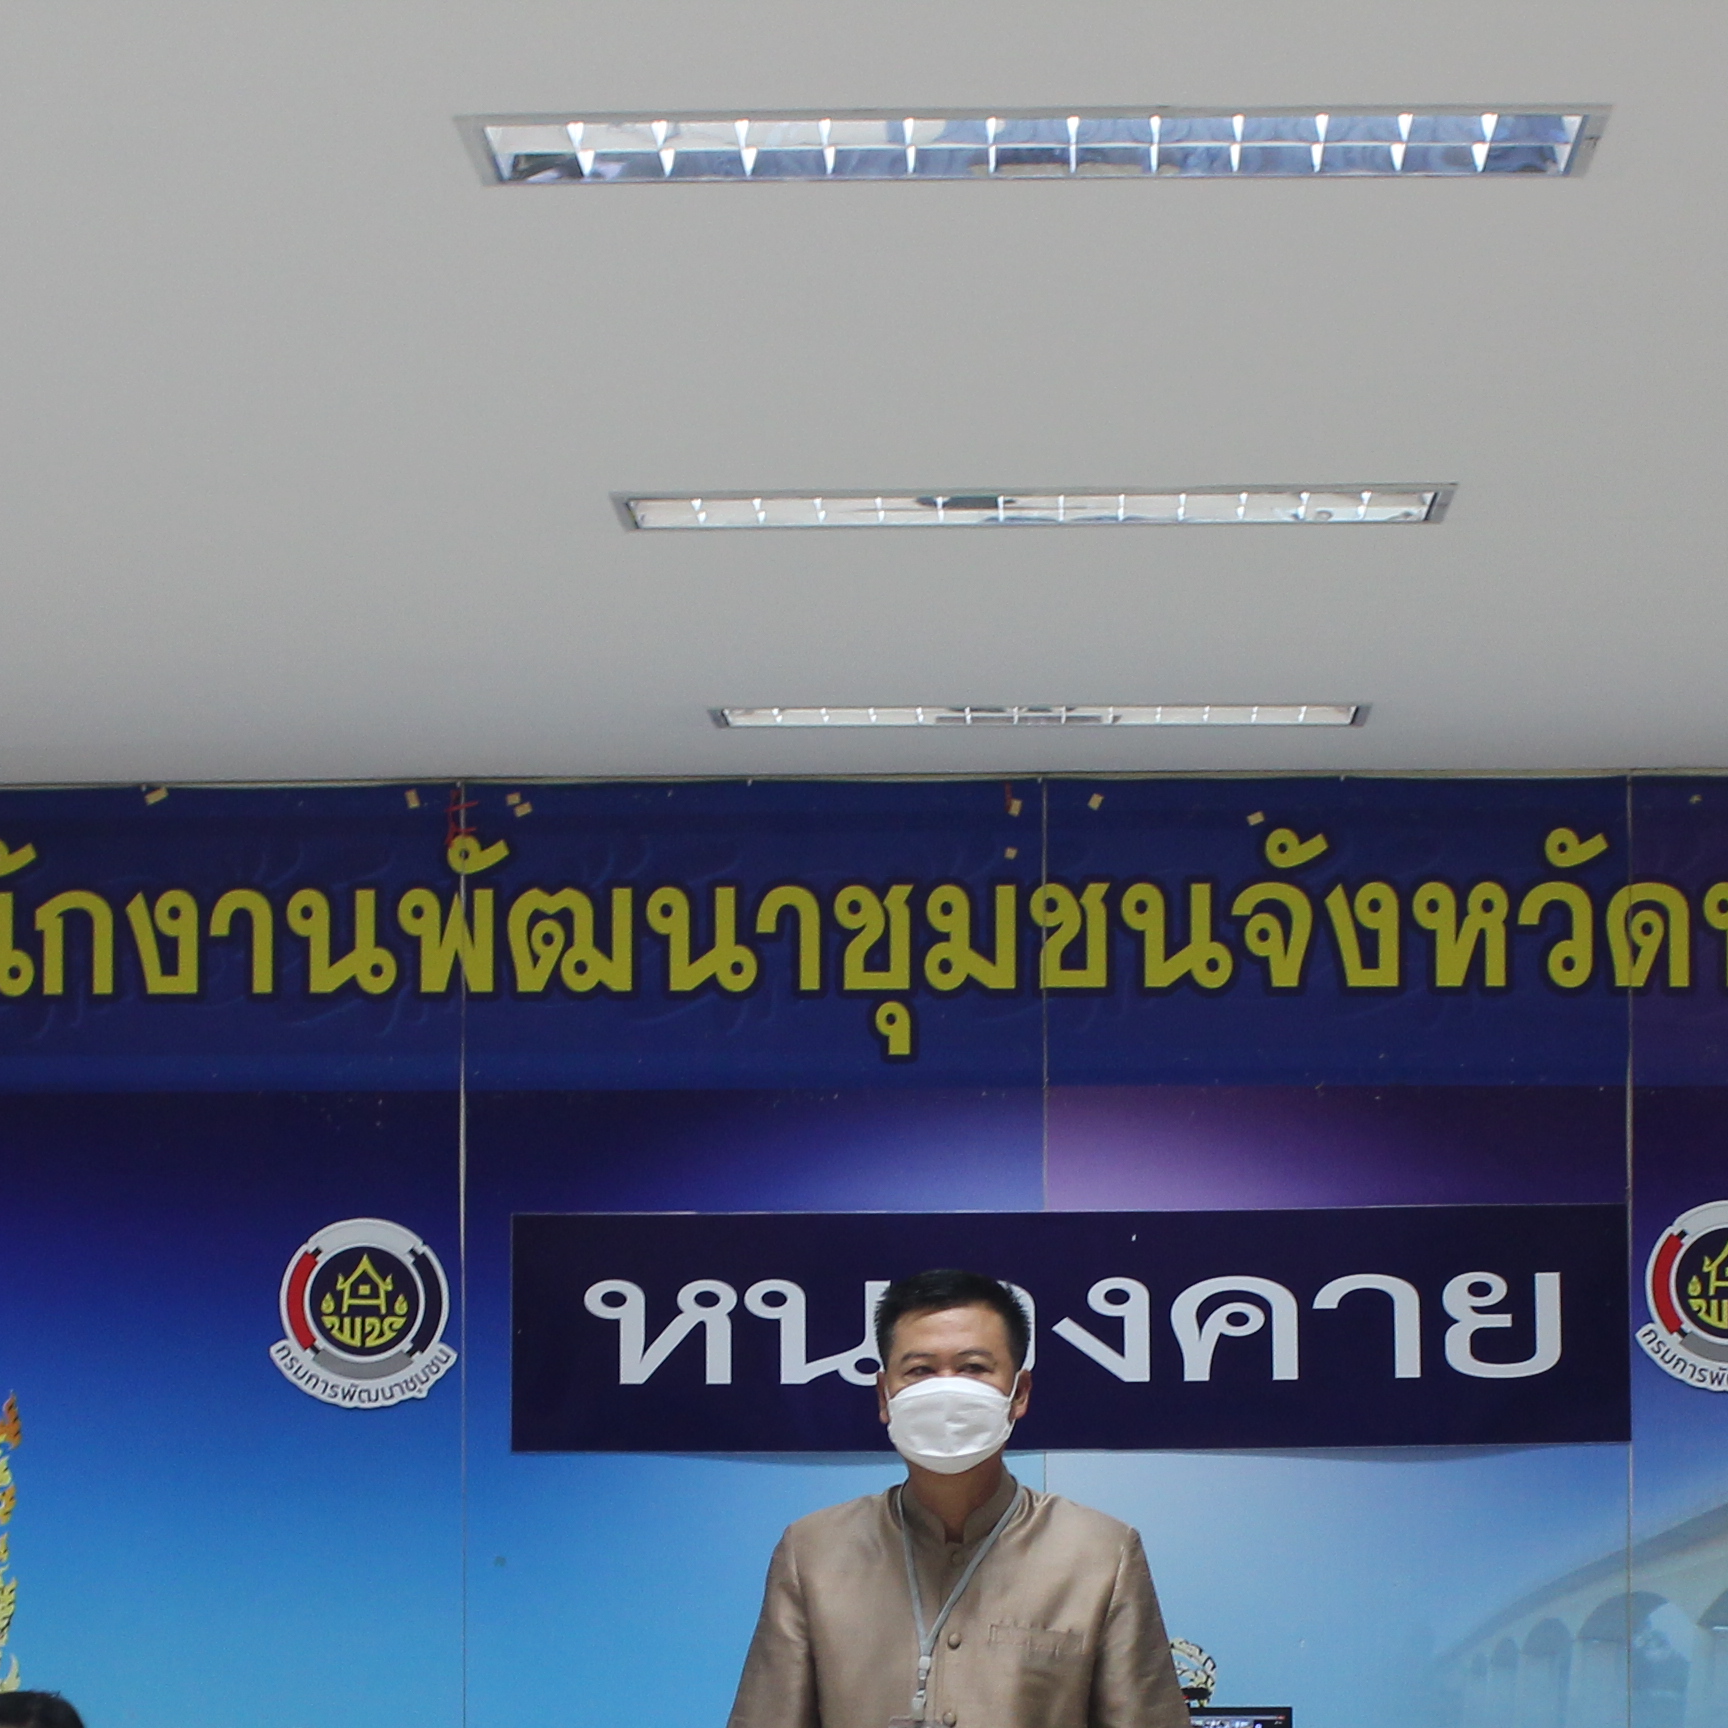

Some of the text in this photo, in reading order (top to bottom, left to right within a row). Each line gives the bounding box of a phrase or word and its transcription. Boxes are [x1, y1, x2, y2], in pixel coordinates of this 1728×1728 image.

[583, 1270, 1562, 1386] หนงคาย
[275, 1344, 453, 1404] กรมการพัฒนาชุมชน
